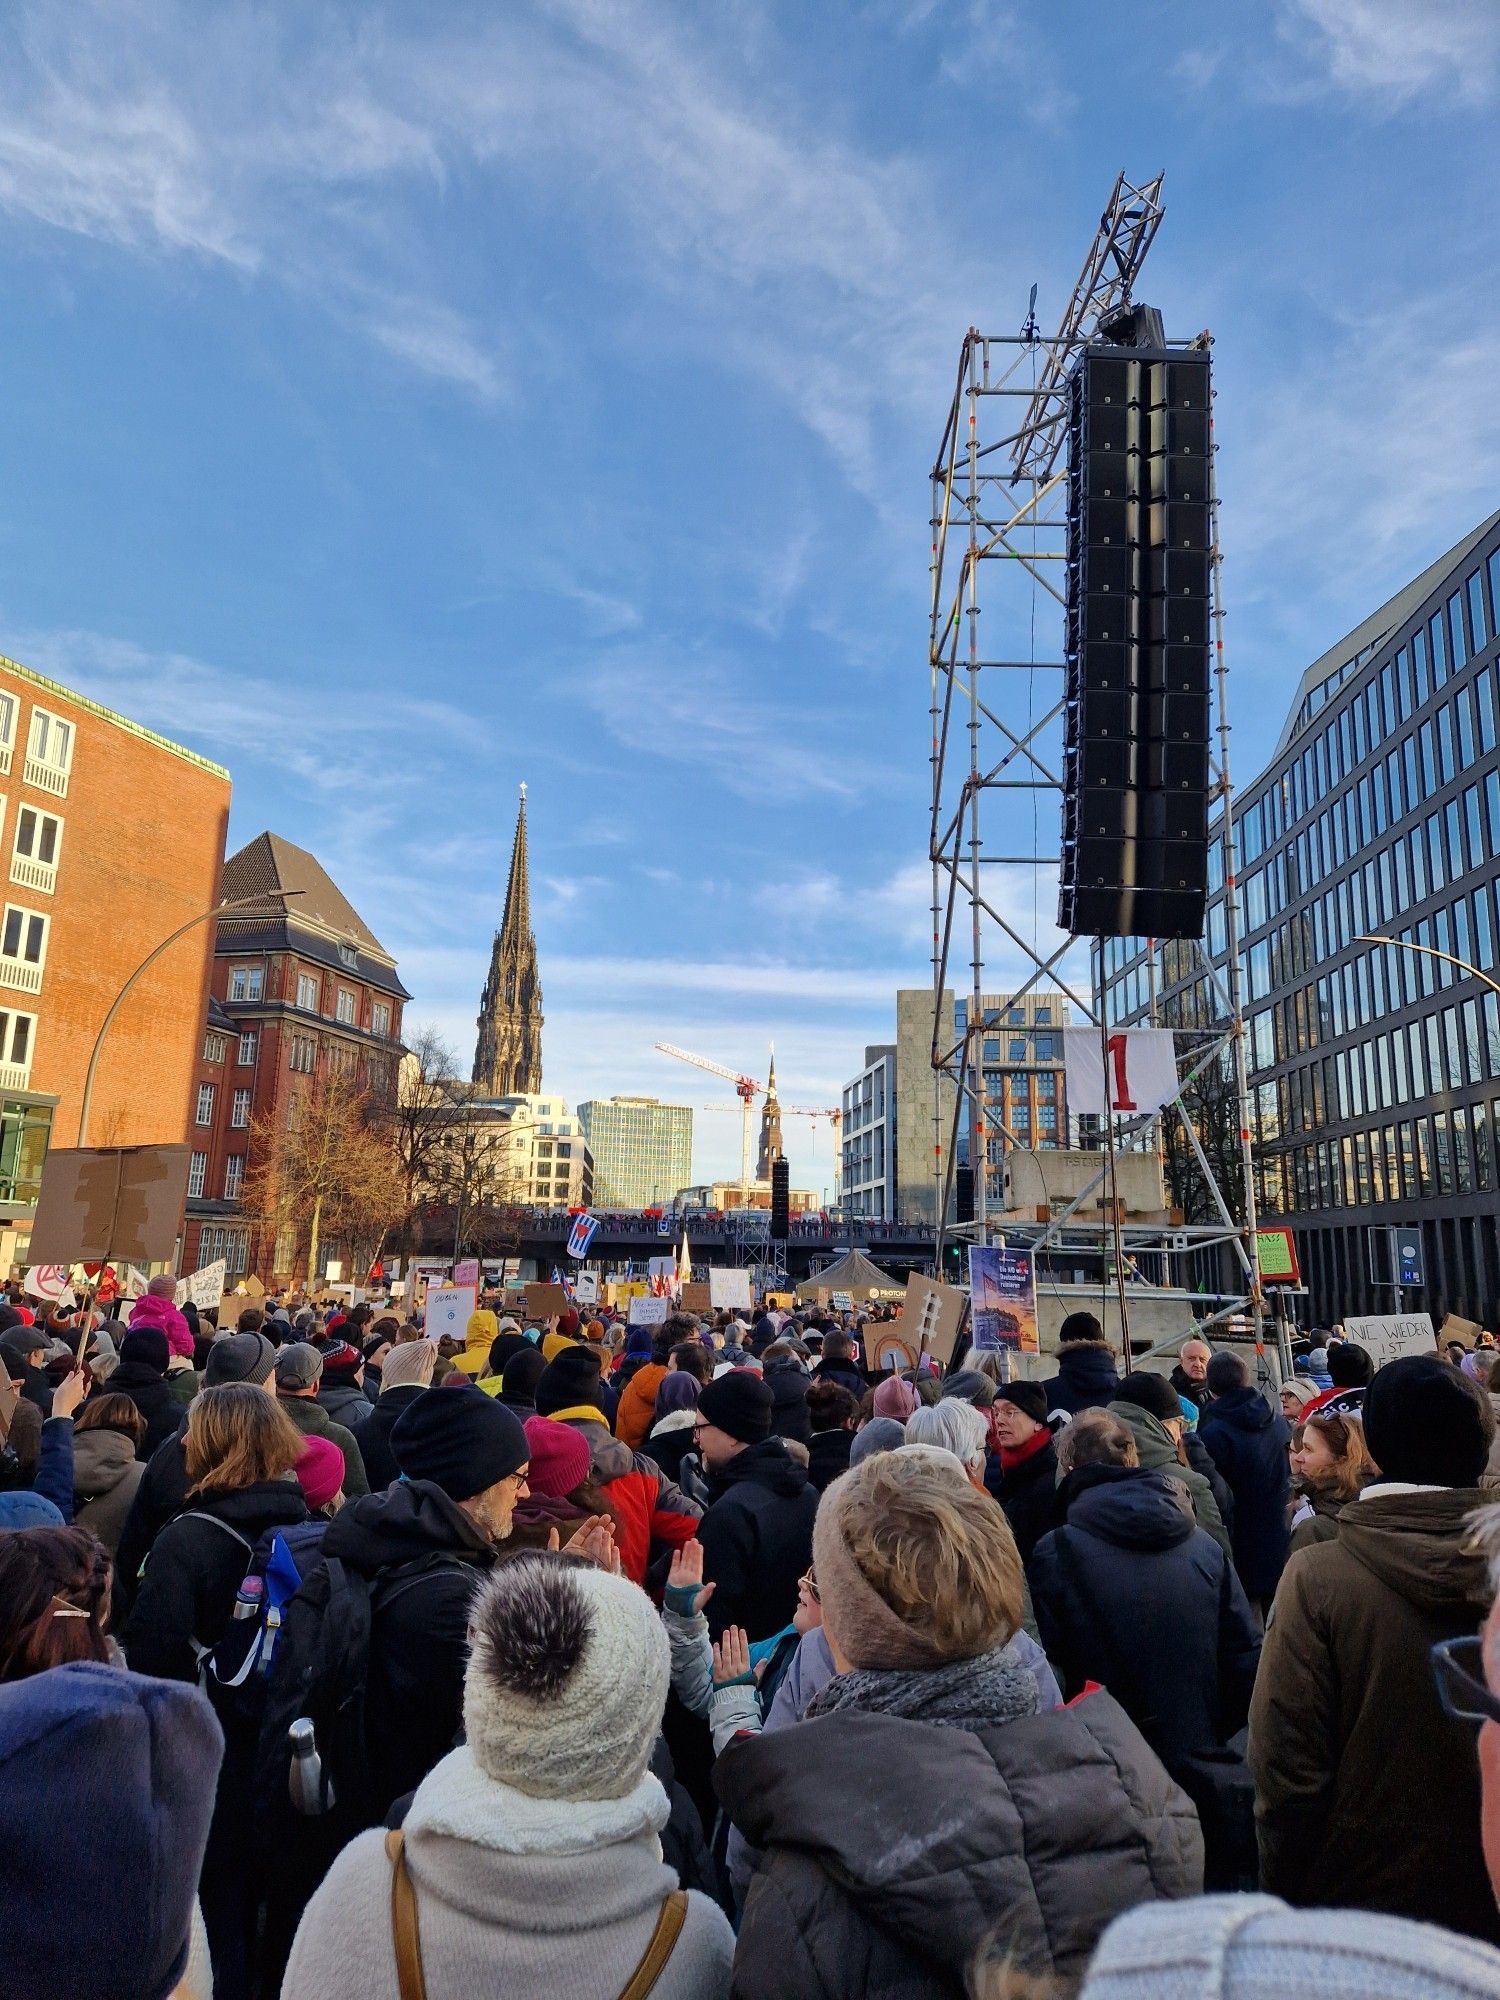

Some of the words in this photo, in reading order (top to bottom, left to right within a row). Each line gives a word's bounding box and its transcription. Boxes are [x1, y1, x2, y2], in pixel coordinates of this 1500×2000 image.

[1107, 1034, 1137, 1111] 1
[1350, 1323, 1378, 1341] NIE
[1381, 1322, 1430, 1339] WIEDER
[1381, 1341, 1406, 1354] IST
